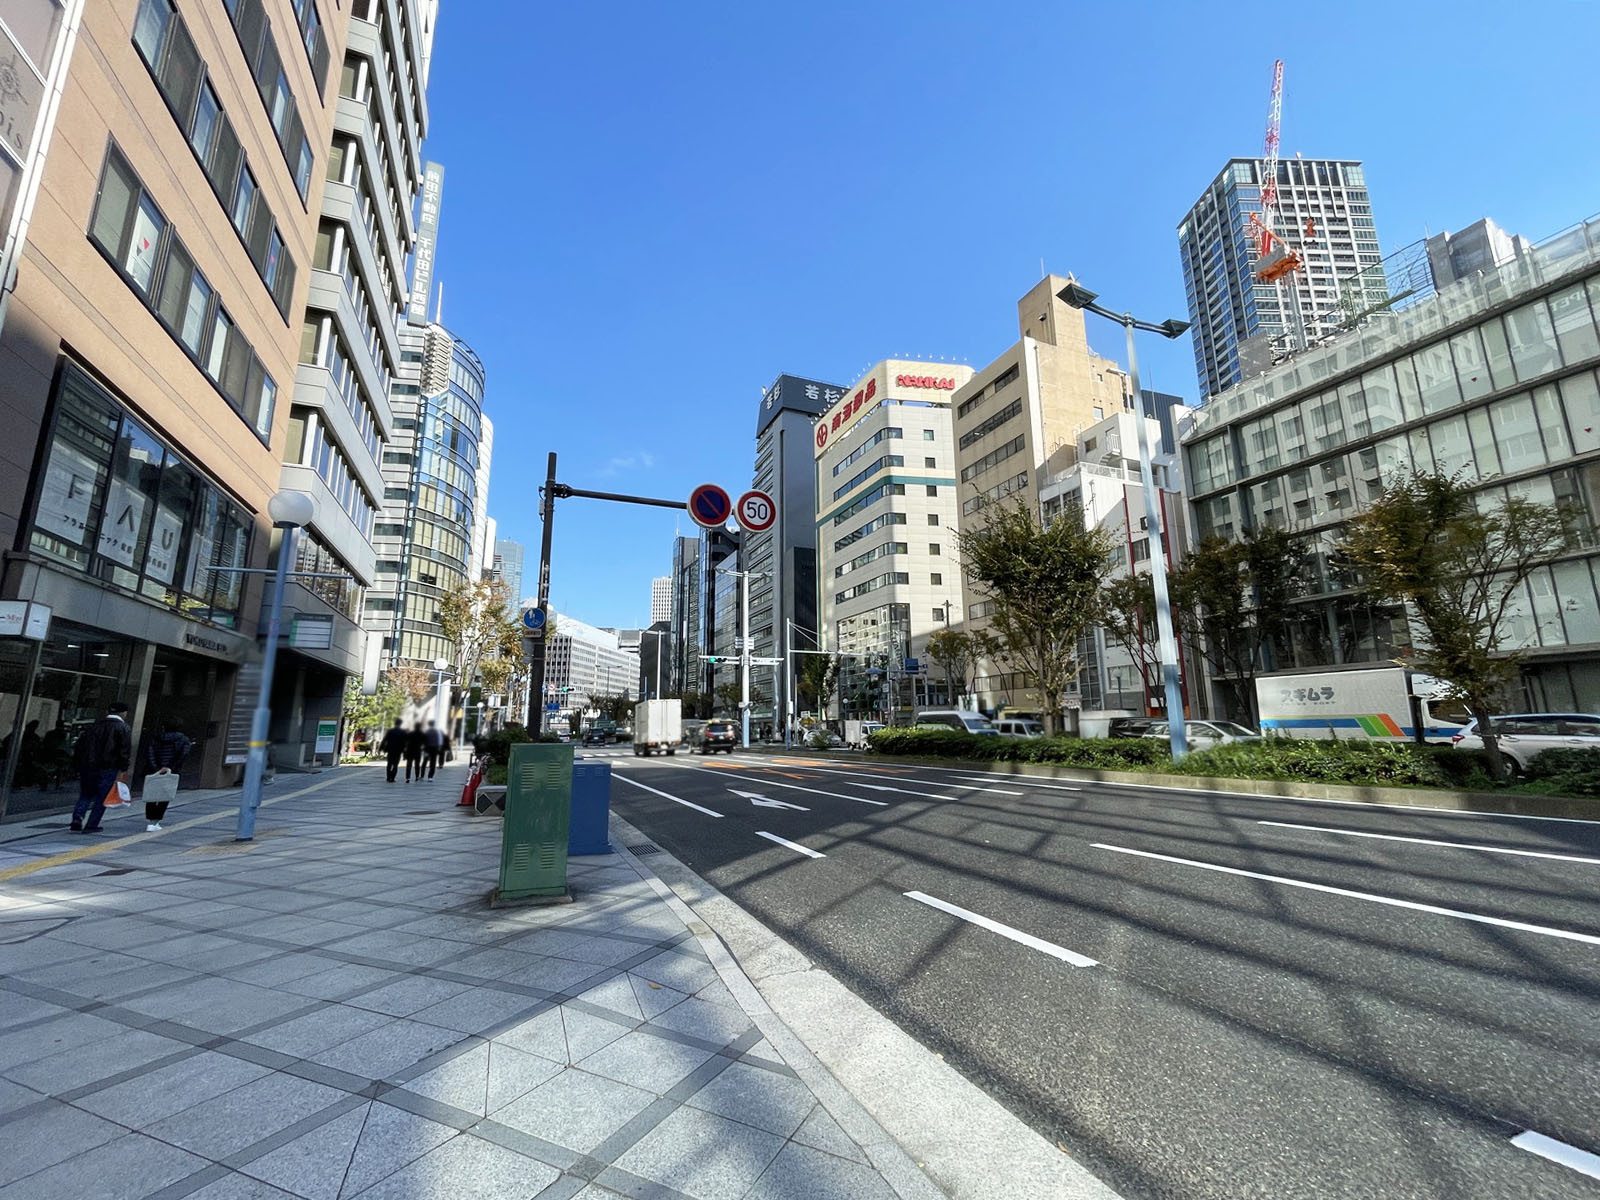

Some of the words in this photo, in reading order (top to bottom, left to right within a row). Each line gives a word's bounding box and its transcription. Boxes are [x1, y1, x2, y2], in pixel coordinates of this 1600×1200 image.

[422, 170, 440, 226] 前田不動産
[896, 374, 955, 391] NANKAI
[804, 384, 840, 404] 若杉
[67, 474, 87, 499] F
[161, 528, 174, 550] U
[746, 501, 768, 520] 50
[1280, 686, 1335, 702] スギムラ
